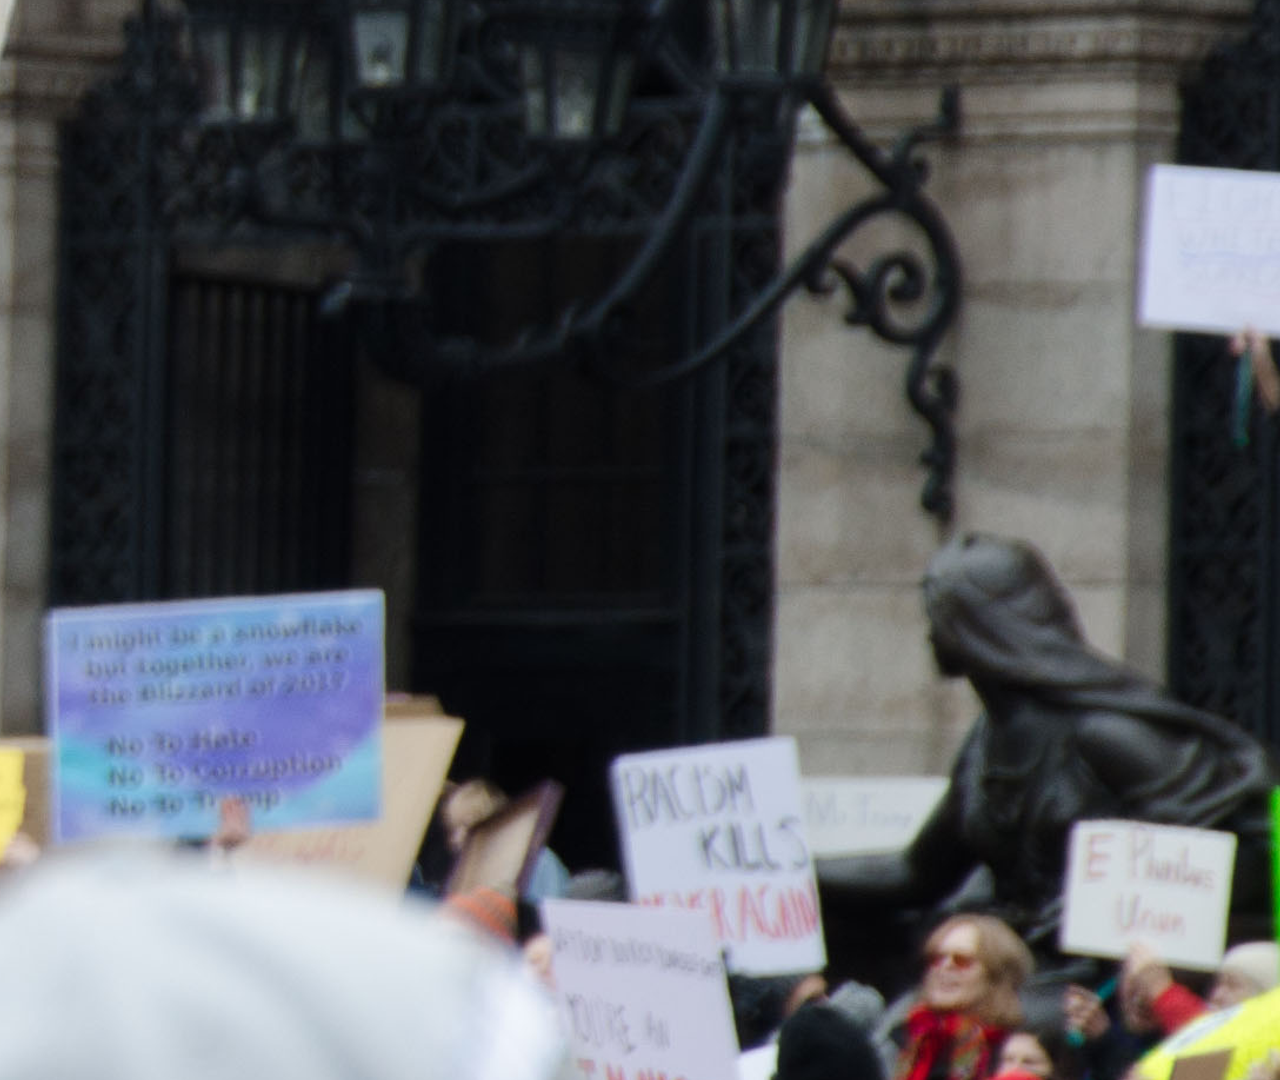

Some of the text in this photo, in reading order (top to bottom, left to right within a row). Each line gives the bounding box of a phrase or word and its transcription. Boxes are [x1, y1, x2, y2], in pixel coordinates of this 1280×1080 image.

[87, 624, 160, 653] might
[170, 626, 198, 646] be
[233, 617, 361, 647] snowflake
[86, 657, 124, 679] but
[261, 652, 294, 668] we
[304, 650, 350, 666] are
[90, 686, 130, 705] the
[139, 678, 238, 704] Blizzard
[247, 677, 278, 699] of
[106, 727, 257, 758] No To Hate
[106, 751, 343, 788] No To Corruption
[106, 796, 146, 819] No
[621, 764, 756, 829] RACISM
[699, 816, 809, 874] KILLS
[1083, 831, 1116, 883] E
